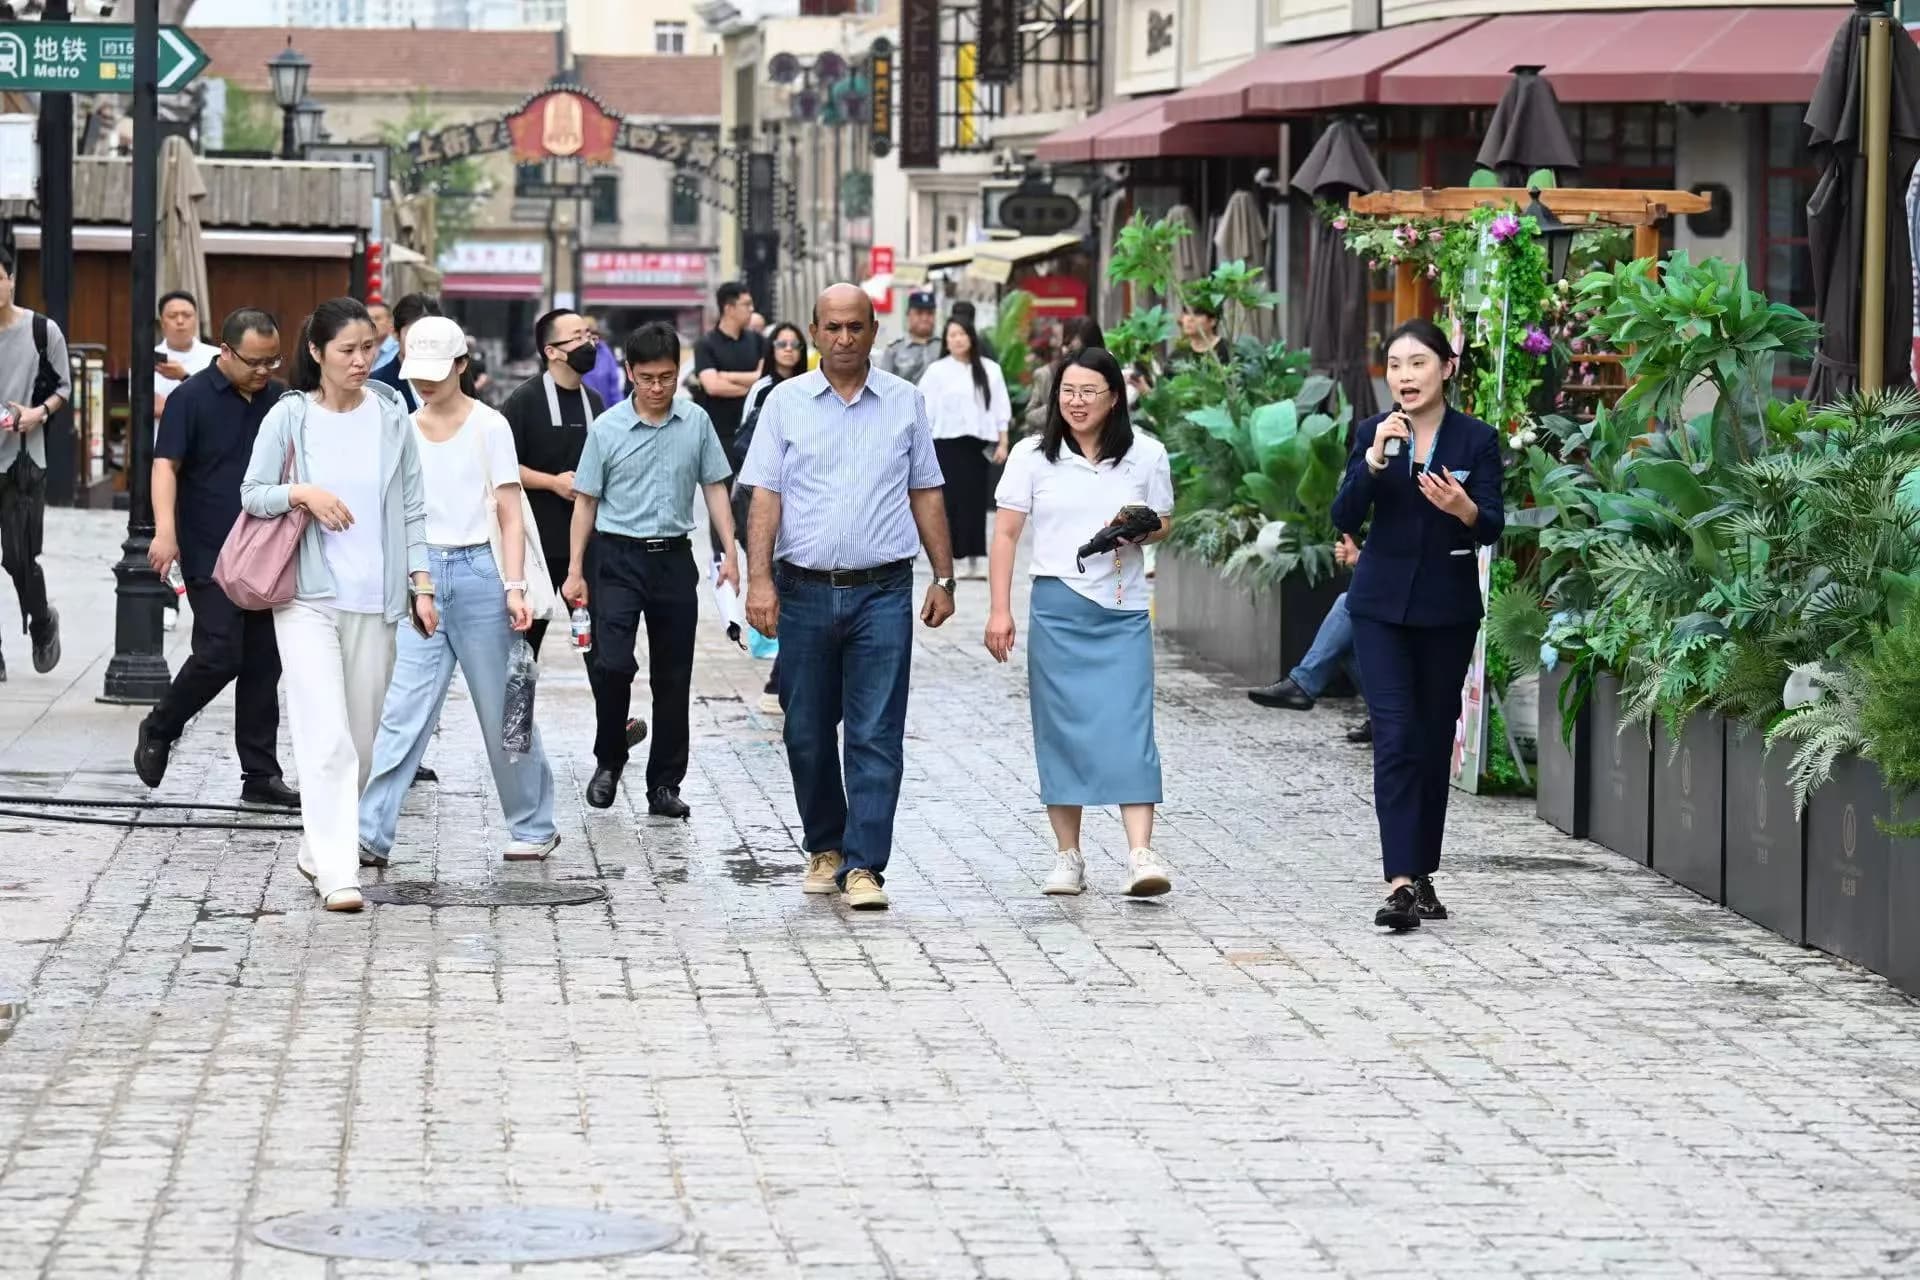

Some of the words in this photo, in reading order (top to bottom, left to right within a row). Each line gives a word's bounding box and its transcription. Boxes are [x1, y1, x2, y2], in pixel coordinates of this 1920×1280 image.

[33, 36, 87, 62] 地铁
[34, 65, 80, 79] Metro
[911, 71, 930, 153] SIDES
